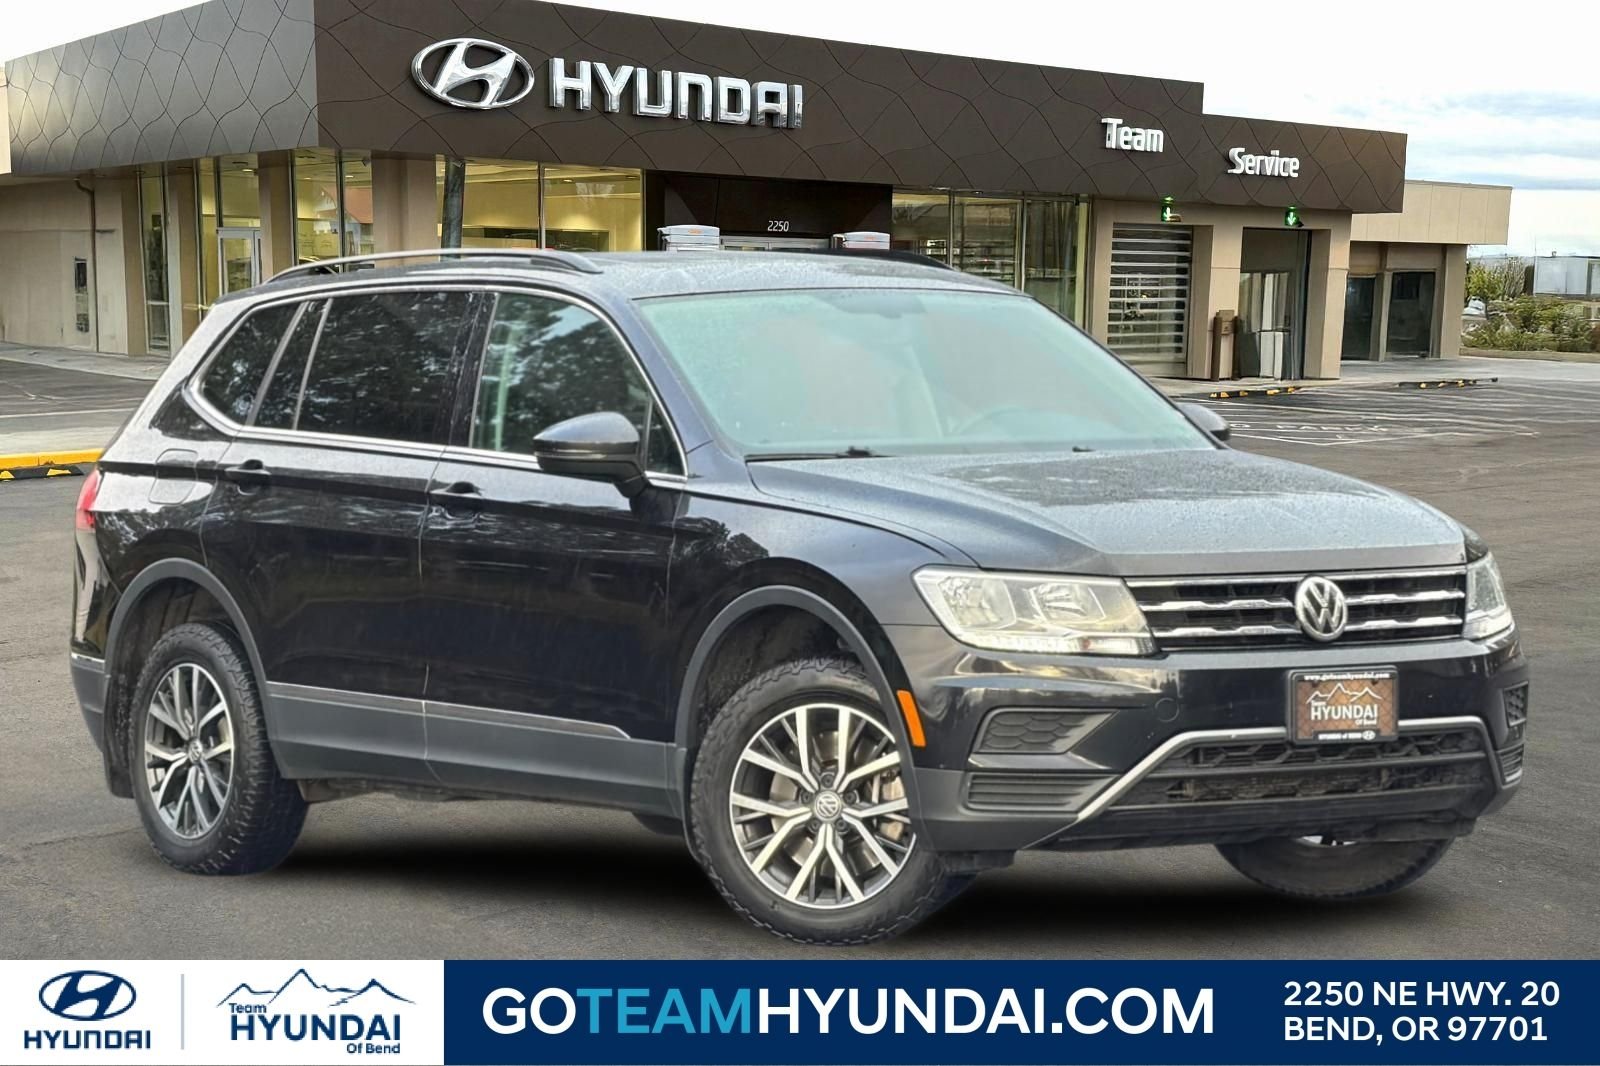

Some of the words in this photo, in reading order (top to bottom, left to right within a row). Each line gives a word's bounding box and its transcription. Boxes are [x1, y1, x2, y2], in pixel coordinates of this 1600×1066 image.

[549, 57, 803, 129] HYUNDAI
[1101, 117, 1164, 153] Team
[1227, 147, 1300, 178] Service
[767, 220, 790, 233] 2250
[1310, 704, 1378, 720] HYUNDAI
